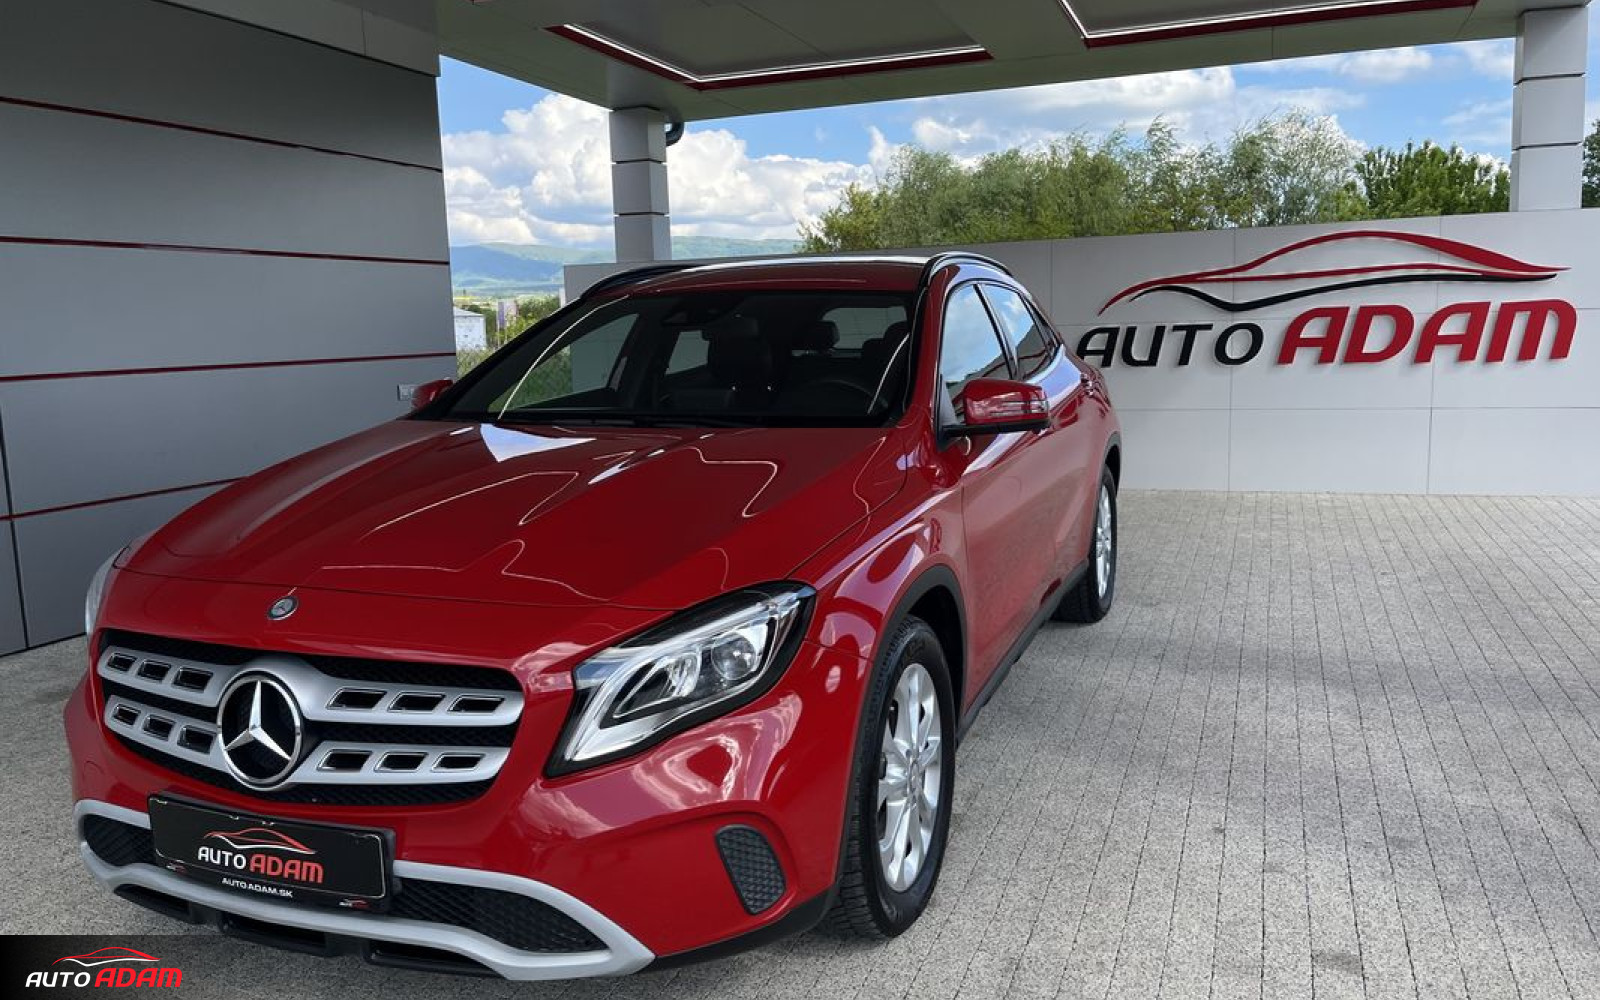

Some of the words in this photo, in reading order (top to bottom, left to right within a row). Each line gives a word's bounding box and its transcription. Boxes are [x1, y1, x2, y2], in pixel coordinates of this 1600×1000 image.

[1076, 322, 1264, 368] AUTO
[1277, 299, 1578, 364] ADAM
[198, 846, 247, 870] AUTO
[250, 853, 324, 884] ADAM
